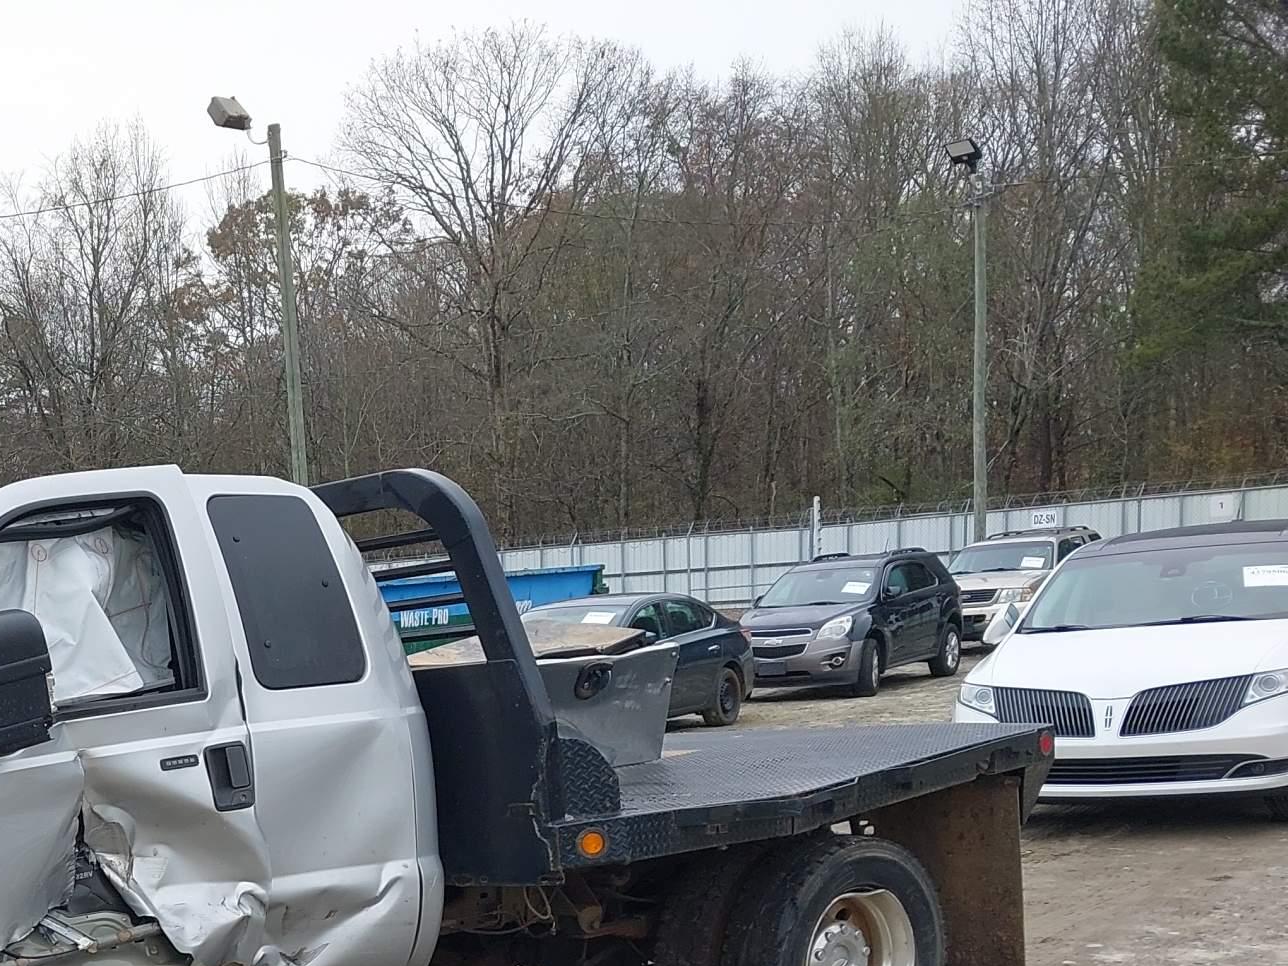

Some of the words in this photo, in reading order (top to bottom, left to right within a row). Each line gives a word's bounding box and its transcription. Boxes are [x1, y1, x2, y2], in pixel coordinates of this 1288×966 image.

[1033, 513, 1056, 525] DZ-SN
[400, 609, 428, 628] WASTE
[432, 608, 449, 625] PRO
